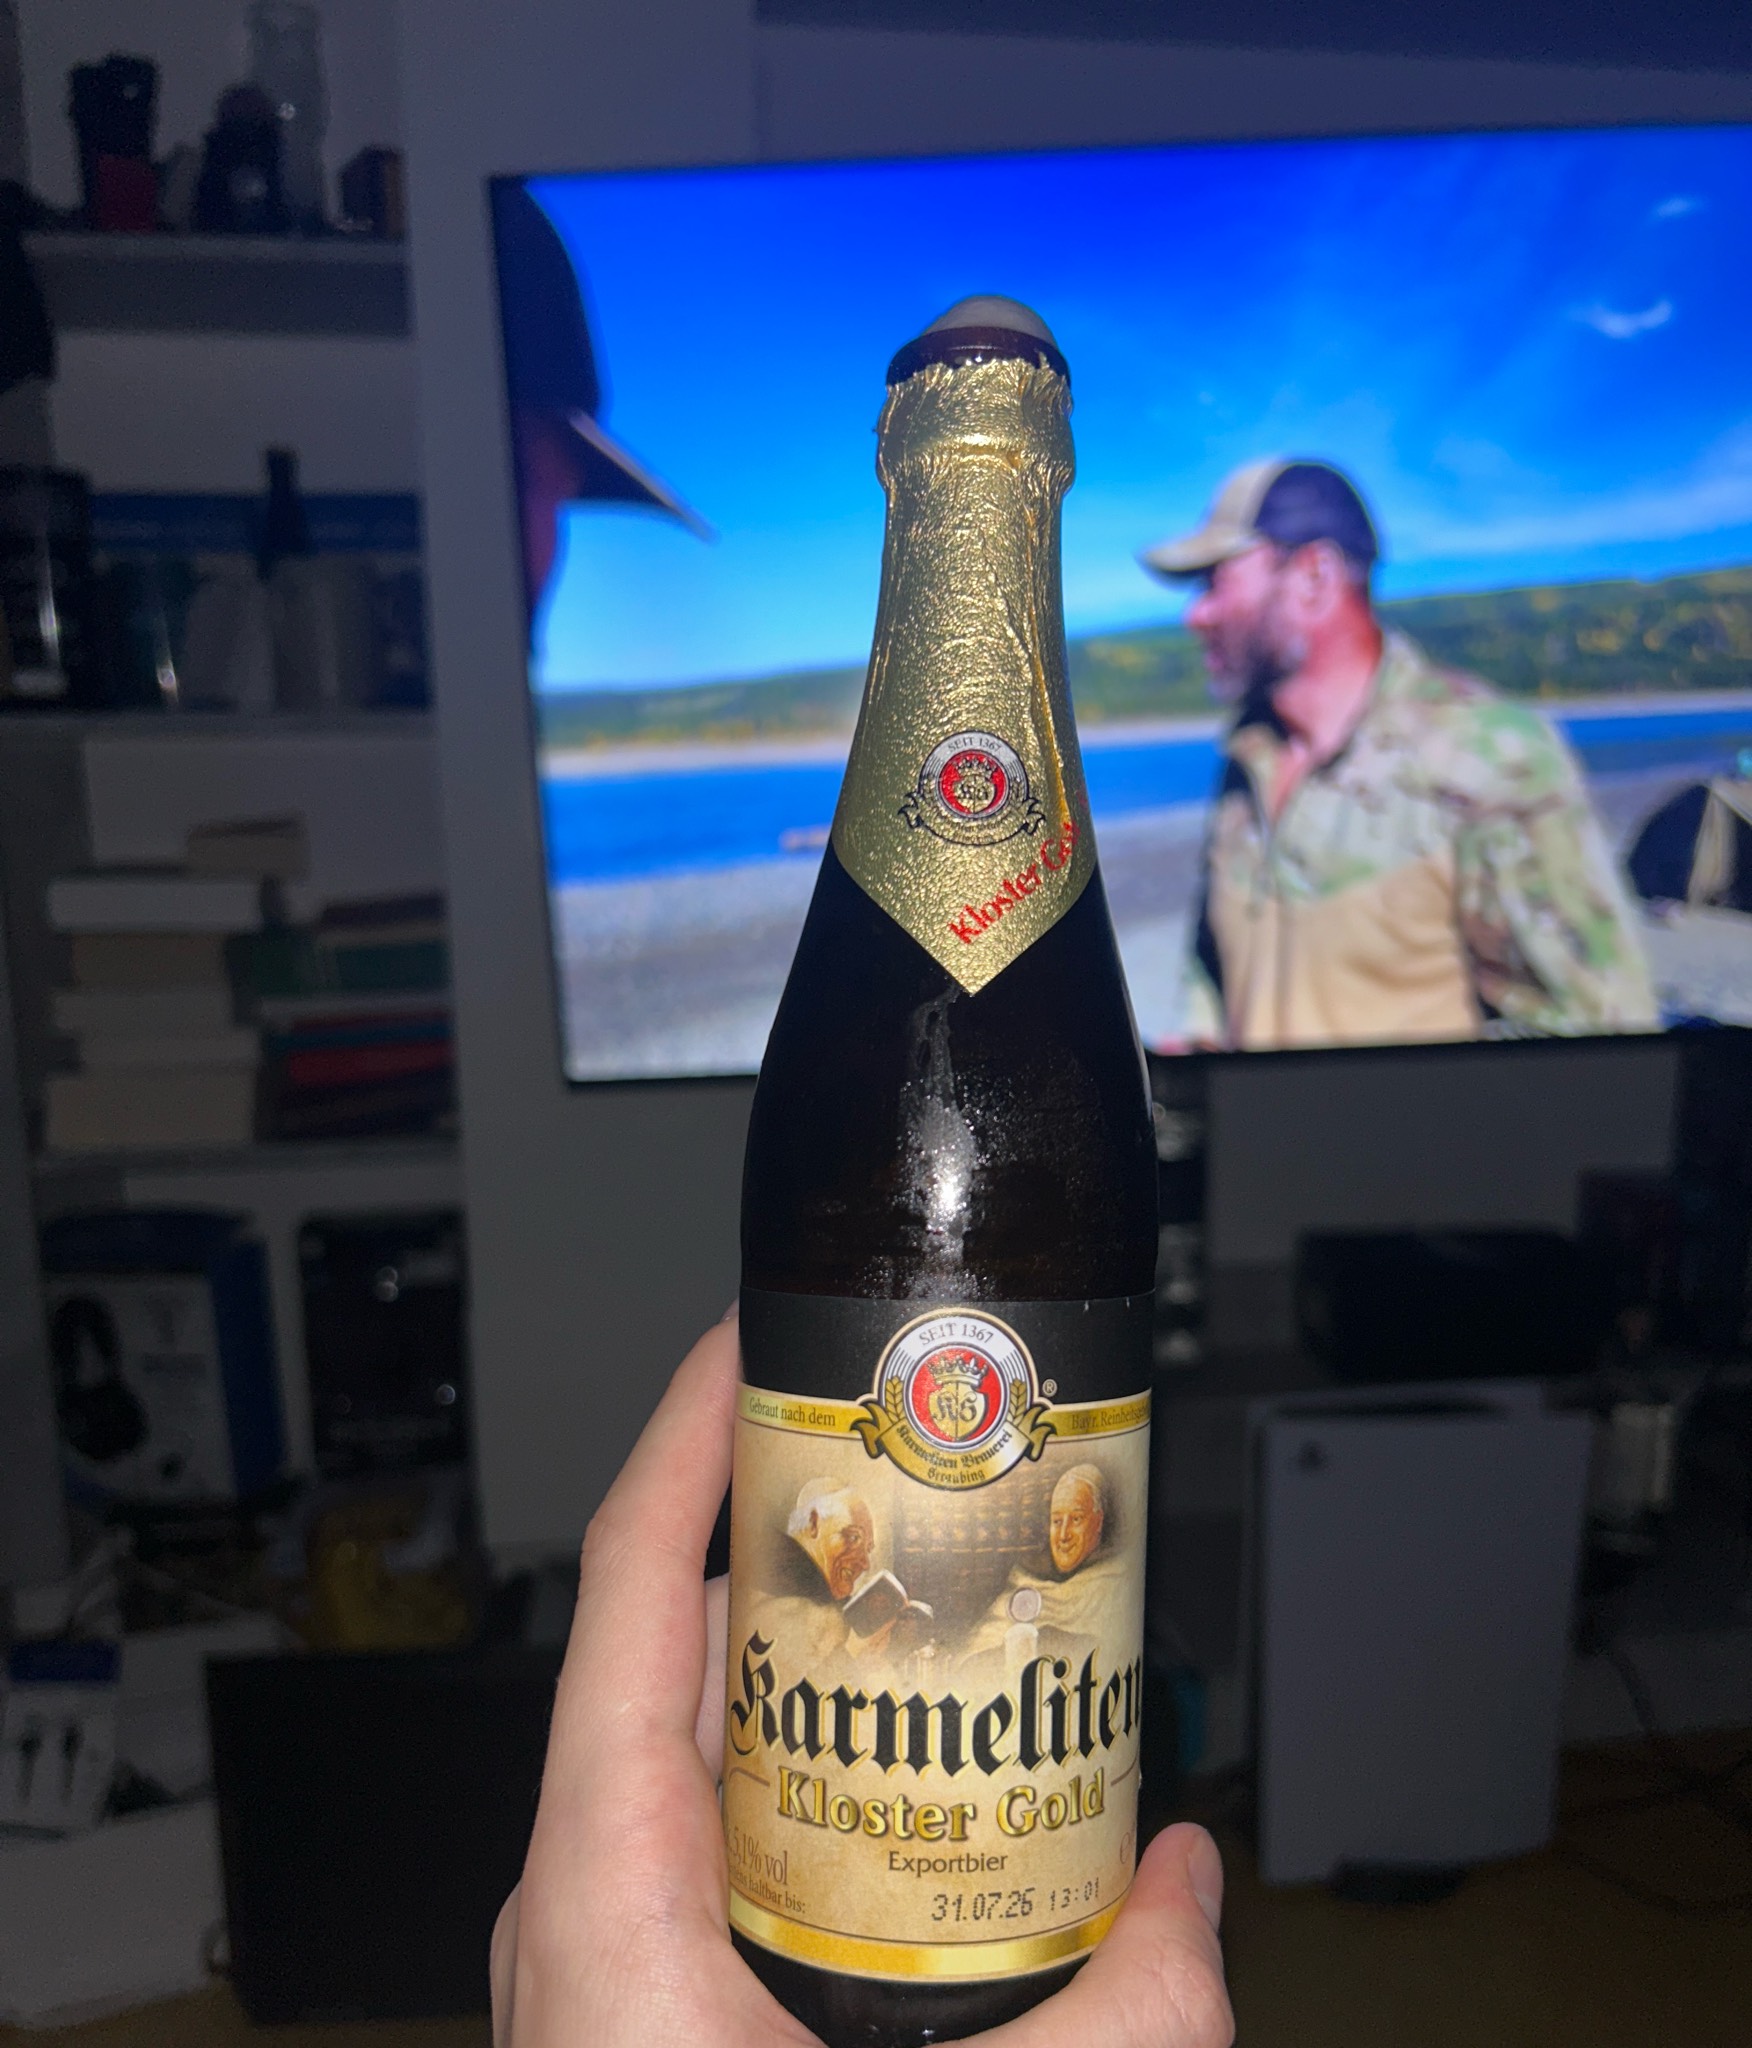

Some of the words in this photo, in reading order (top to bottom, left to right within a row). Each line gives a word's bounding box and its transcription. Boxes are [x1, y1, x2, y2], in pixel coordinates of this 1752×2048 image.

[948, 737, 974, 751] SEIT
[980, 738, 1001, 752] 1367
[948, 863, 1042, 944] Kloster
[919, 1322, 956, 1346] SEIT
[961, 1325, 994, 1344] 1367
[749, 1397, 779, 1419] Gebraut
[781, 1405, 806, 1423] nach
[808, 1408, 836, 1426] dem
[1072, 1414, 1097, 1430] Bayr.
[961, 1429, 1013, 1467] Brauerei
[927, 1467, 985, 1485] Straubing
[730, 1630, 1141, 1778] Karmeliten
[777, 1766, 976, 1841] Kloster
[996, 1767, 1105, 1837] Gold
[764, 1850, 788, 1886] vol
[889, 1851, 1008, 1878] Exportbier
[749, 1874, 782, 1905] haltbar
[785, 1891, 806, 1914] bis:
[931, 1887, 1036, 1921] 31.07.26
[1050, 1877, 1099, 1911] 13:01
